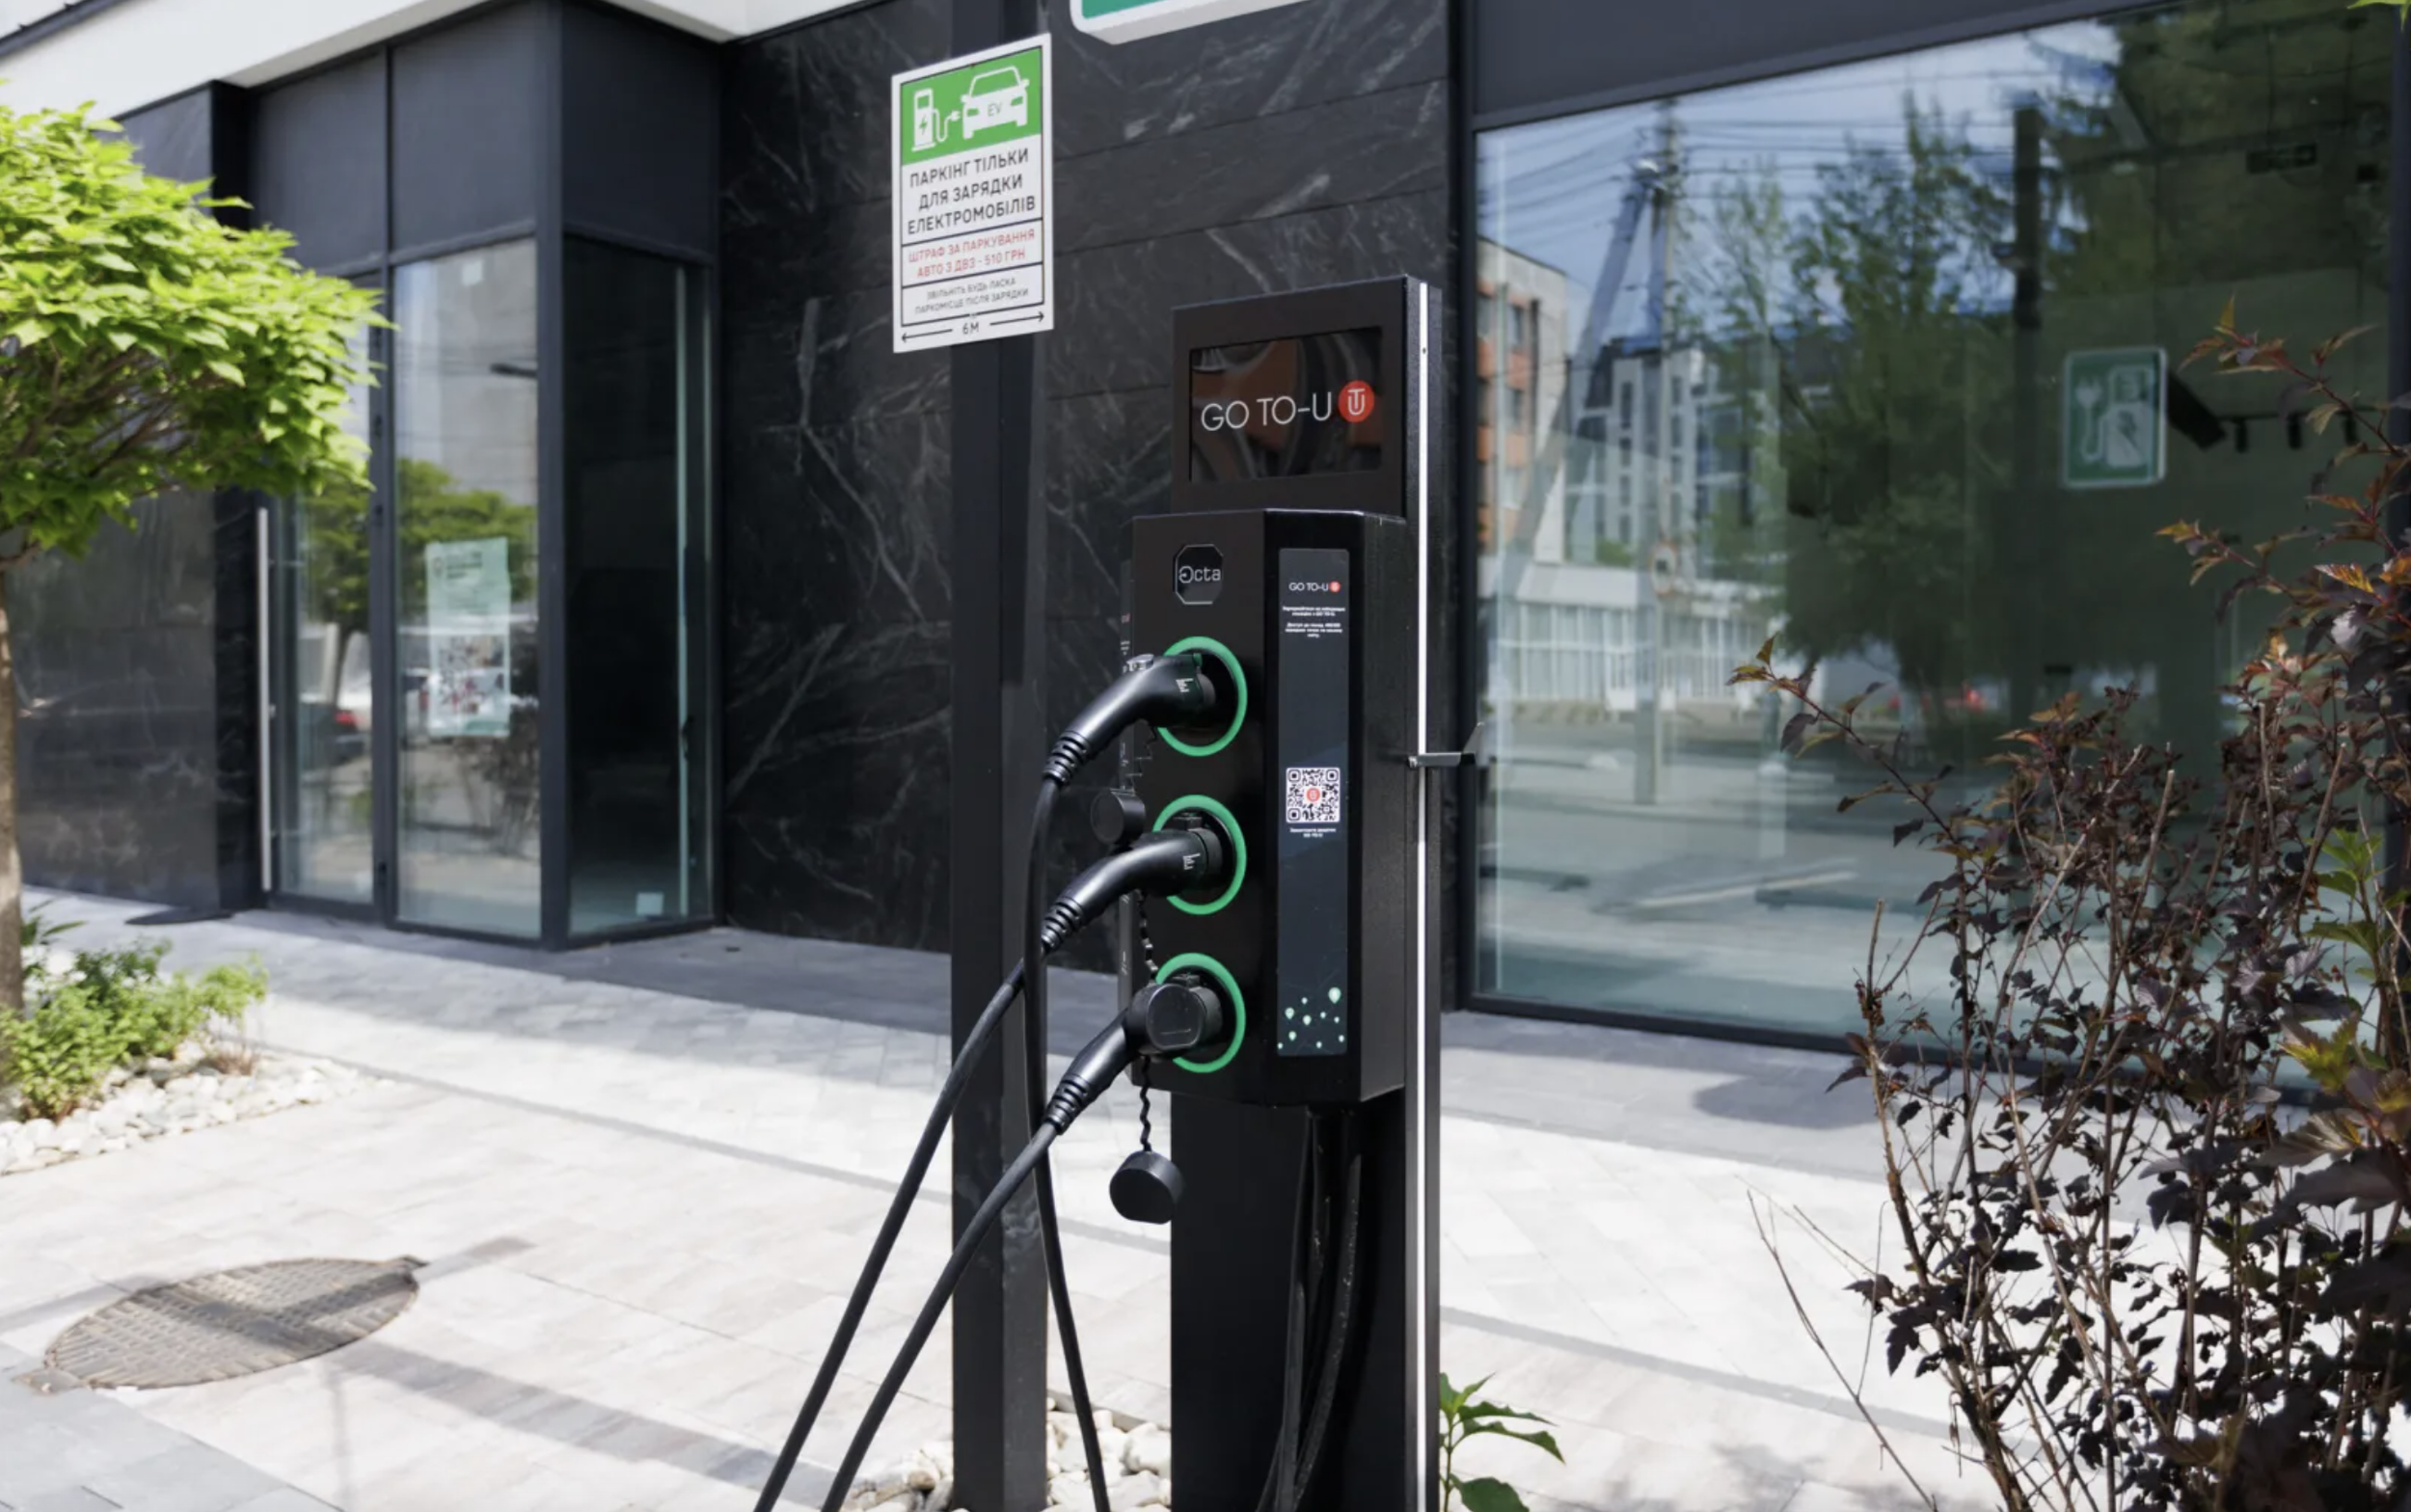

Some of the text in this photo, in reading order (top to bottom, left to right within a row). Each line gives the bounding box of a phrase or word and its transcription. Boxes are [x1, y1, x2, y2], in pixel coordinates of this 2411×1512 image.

[988, 100, 1003, 117] EV
[909, 148, 1029, 188] ПАРКІНГ ТІЛЬКИ
[919, 174, 1023, 211] ДЛЯ ЗАРЯДКИ
[908, 195, 1036, 235] ЕЛЕКТРОМОБІЛІВ
[908, 229, 1035, 263] ШТРАФ ЗА ПАРКУВАННЯ
[917, 264, 944, 279] АВТО
[985, 252, 1003, 266] 510
[1005, 248, 1026, 261] ГРН
[967, 282, 989, 293] БУДЬ
[989, 277, 1016, 289] ЛАСКА
[991, 288, 1029, 303] ЗАРЯДКИ
[1200, 399, 1250, 432] GO
[1256, 391, 1333, 427] TO-U
[1288, 581, 1305, 591] GO
[1306, 581, 1329, 592] TO-U
